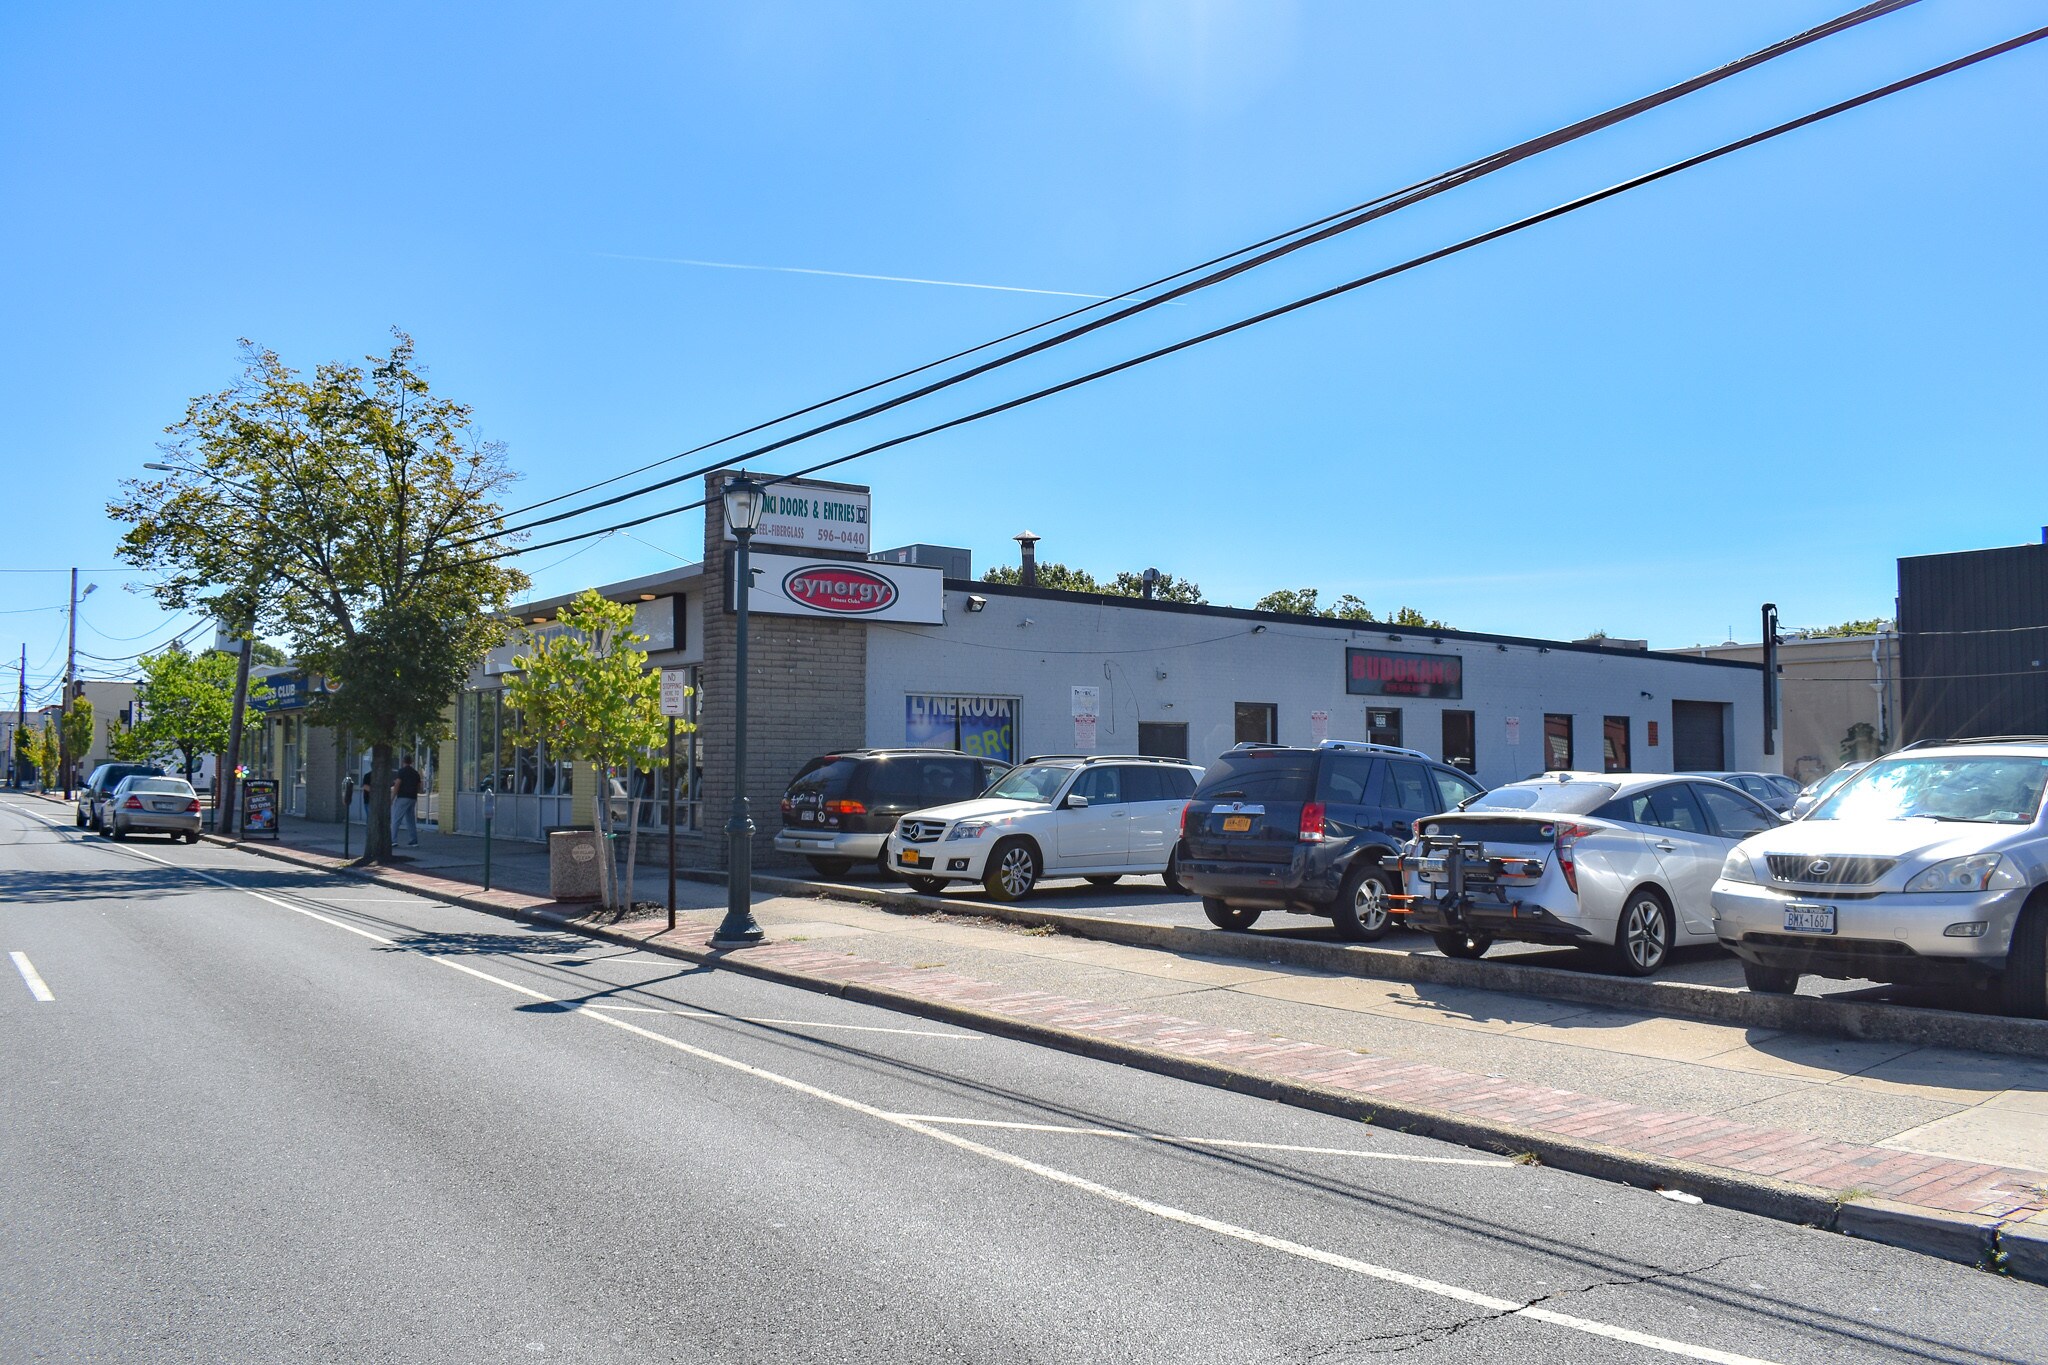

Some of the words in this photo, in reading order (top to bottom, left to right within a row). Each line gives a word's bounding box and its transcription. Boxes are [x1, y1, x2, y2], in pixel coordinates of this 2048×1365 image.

[779, 496, 808, 518] DOORS
[812, 500, 819, 519] &
[823, 501, 855, 523] ENTRIES
[817, 528, 865, 545] 596-0440
[793, 578, 888, 603] synergy
[667, 673, 676, 681] NO
[1352, 655, 1444, 684] BUDOKAN
[277, 684, 296, 698] CLUB
[663, 682, 682, 690] STOPPING
[911, 696, 1011, 717] LYNBROOK
